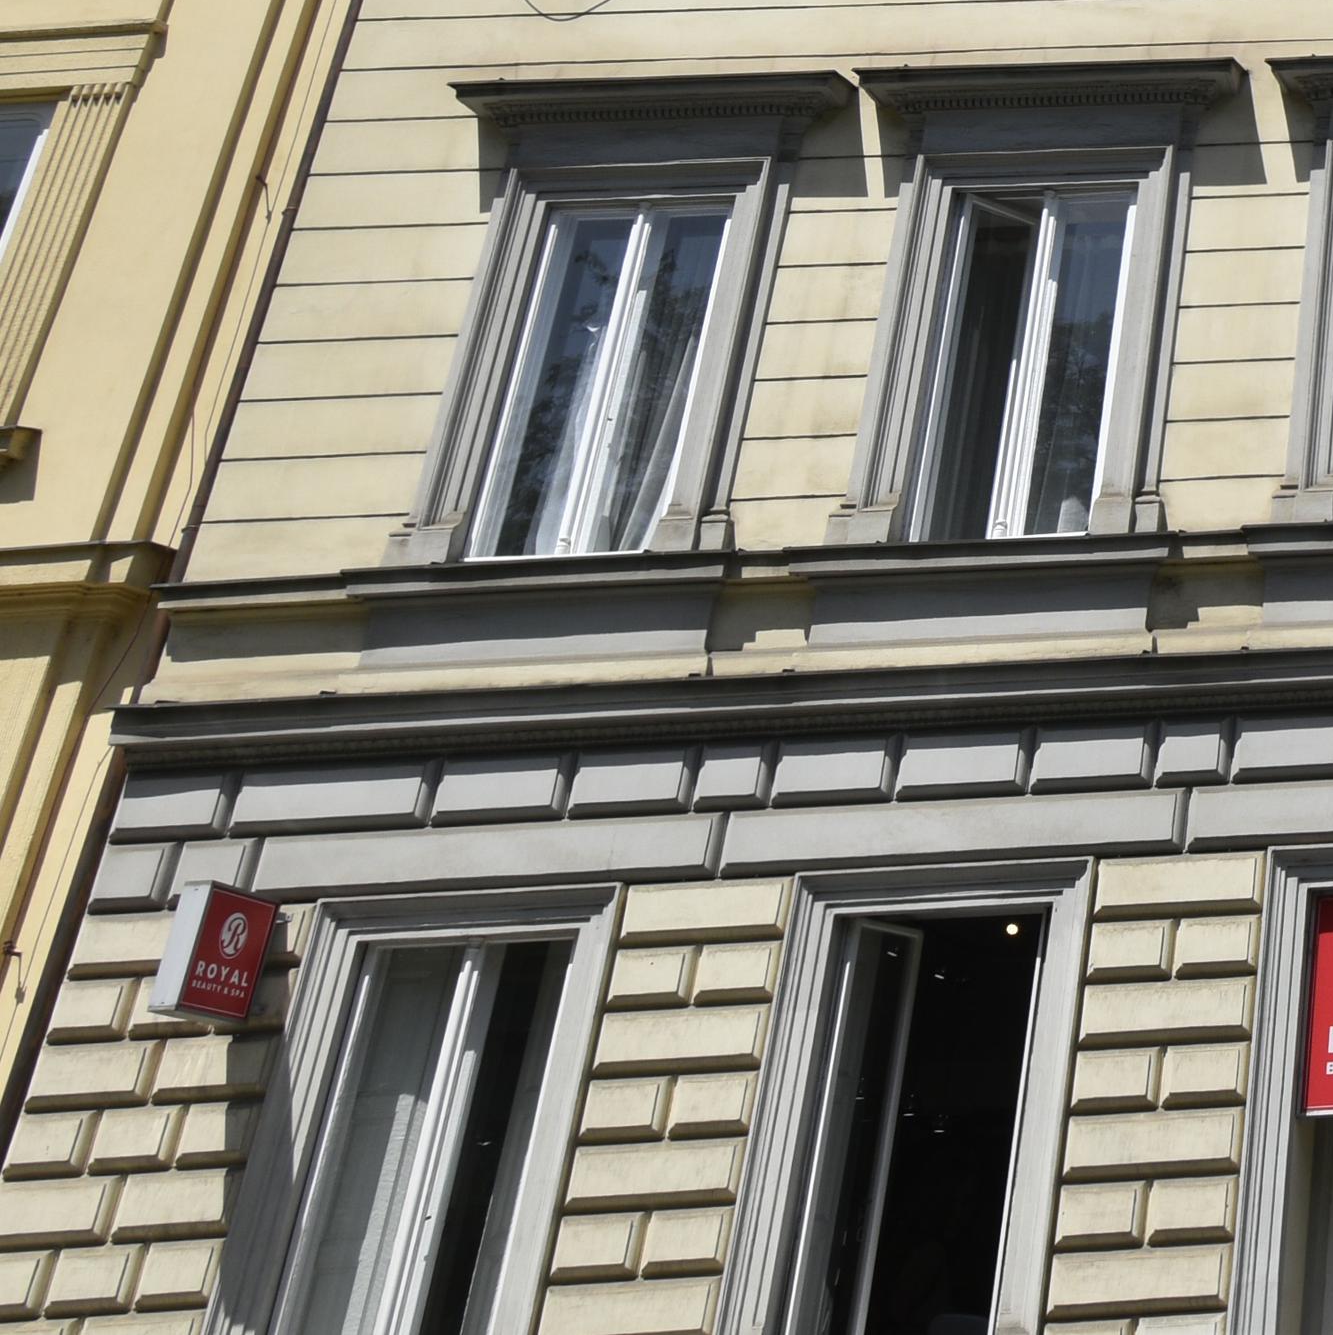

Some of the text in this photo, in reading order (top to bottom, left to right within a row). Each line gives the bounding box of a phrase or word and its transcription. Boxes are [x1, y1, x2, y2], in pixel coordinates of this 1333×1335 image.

[194, 960, 249, 987] ROYAL
[191, 980, 245, 998] BEAUTY & SPA
